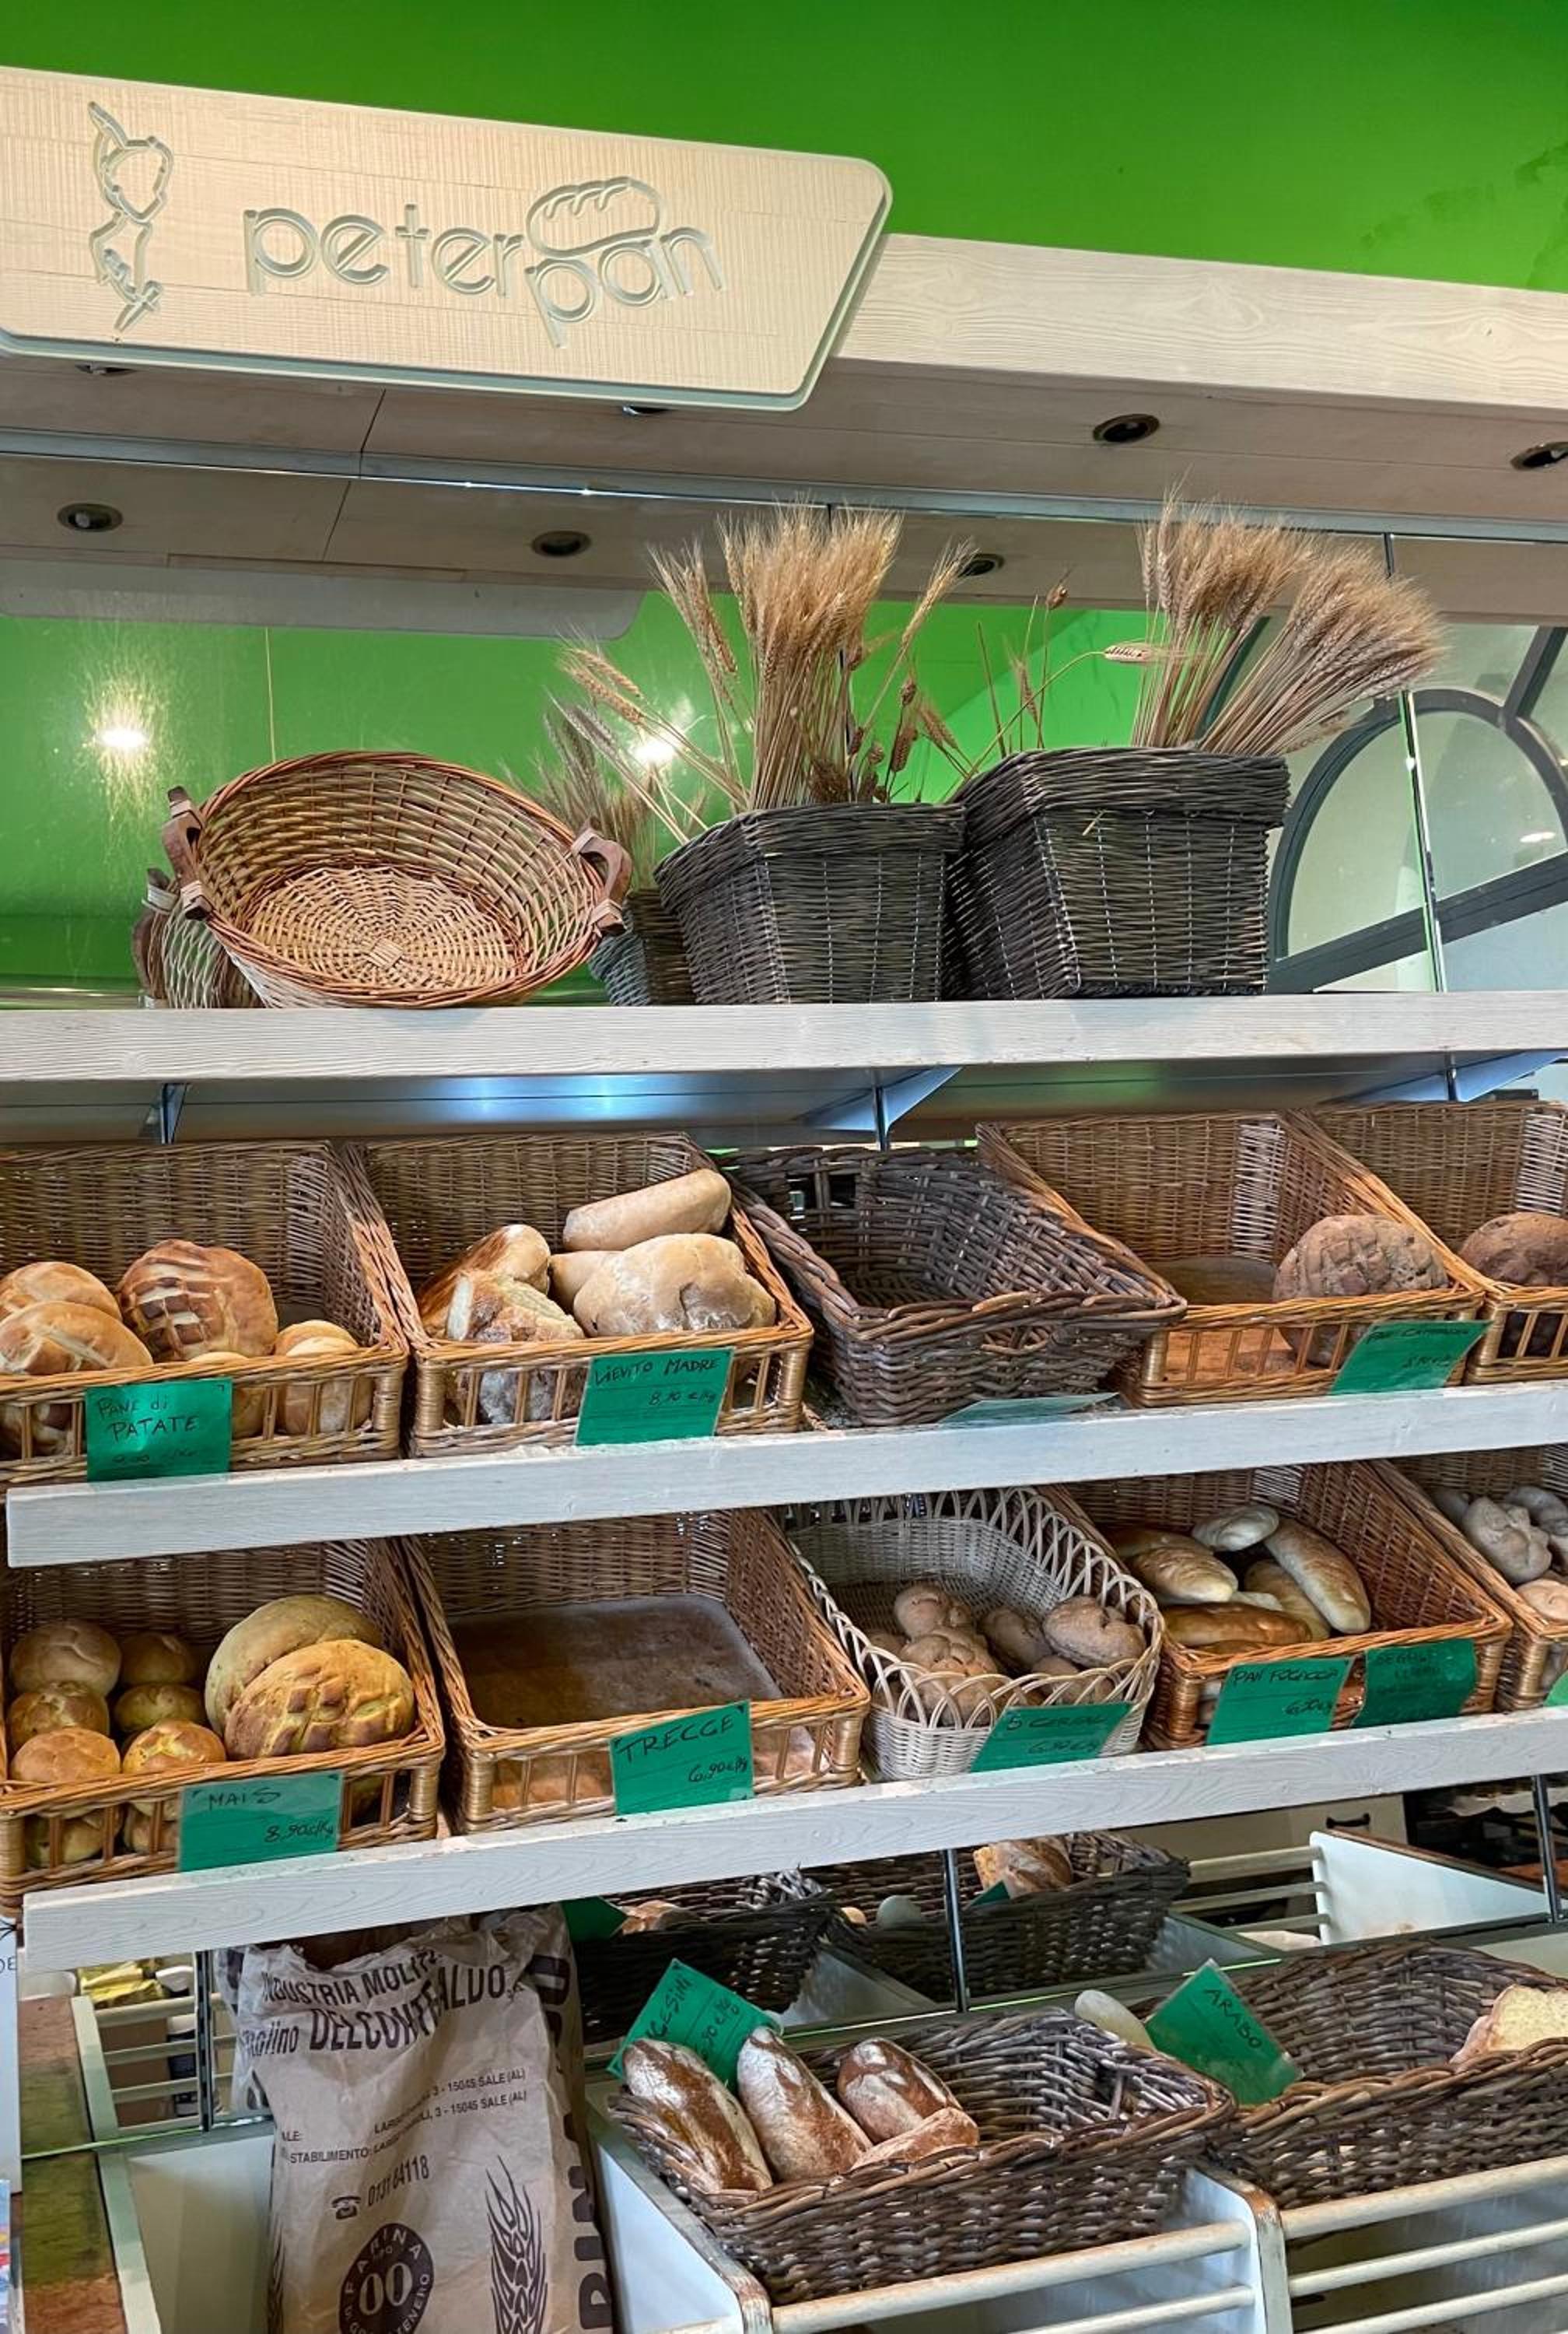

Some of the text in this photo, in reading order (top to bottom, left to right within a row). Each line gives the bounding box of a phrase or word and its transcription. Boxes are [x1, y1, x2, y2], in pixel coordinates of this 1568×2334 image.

[594, 1358, 722, 1386] LIEVITO MADRE
[97, 1397, 141, 1420] PANE
[107, 1414, 200, 1442] PATATE
[1232, 1666, 1265, 1687] PAN
[208, 1786, 282, 1813] MAIS
[1203, 1987, 1264, 2049] ARABO
[358, 2262, 414, 2316] 00
